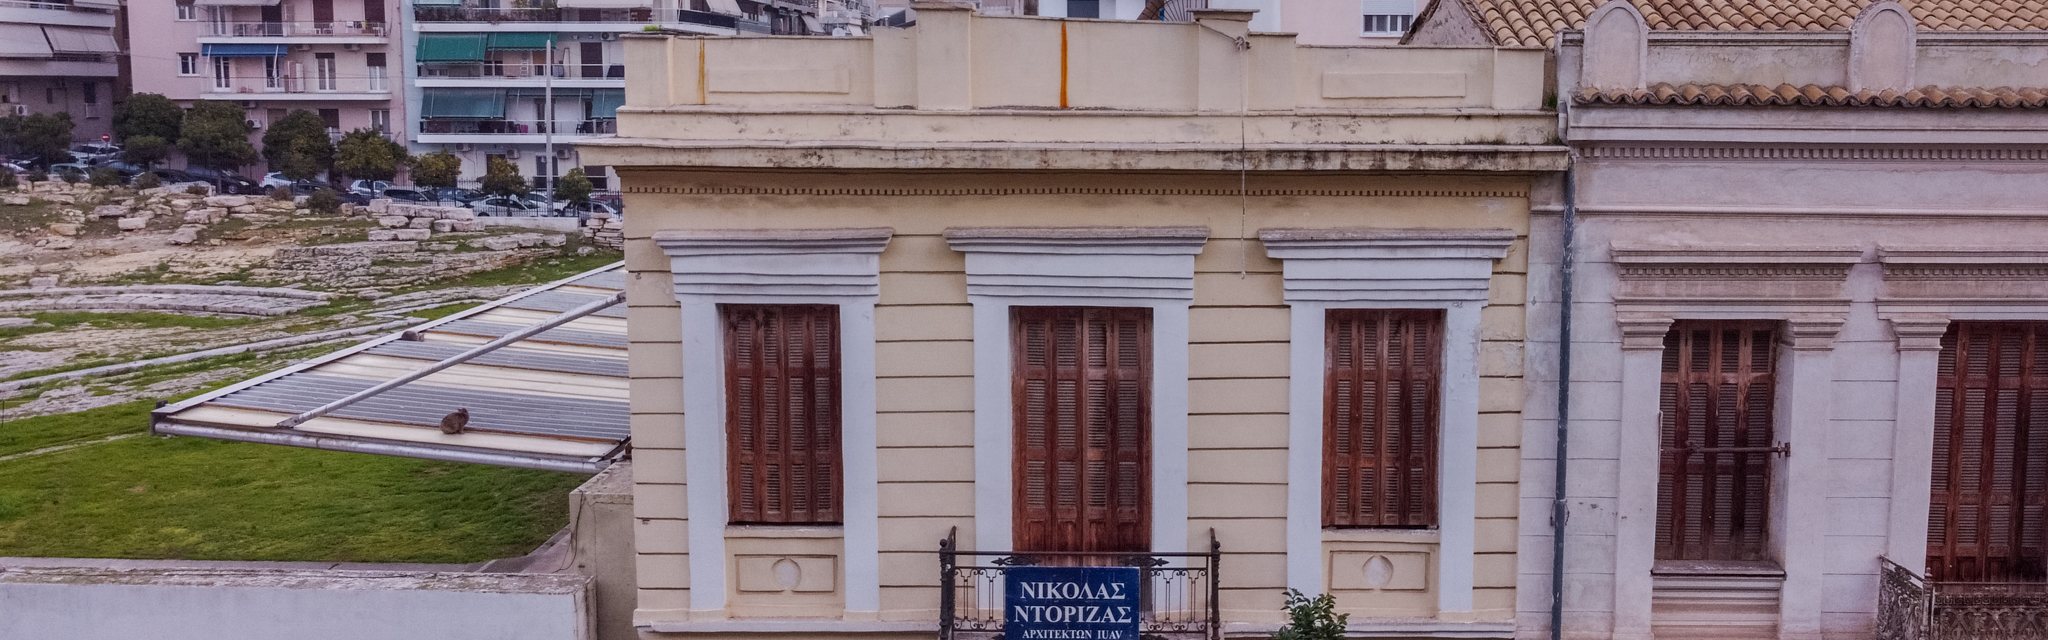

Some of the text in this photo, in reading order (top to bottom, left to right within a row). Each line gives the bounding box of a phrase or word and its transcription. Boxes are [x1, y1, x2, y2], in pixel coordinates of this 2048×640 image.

[1020, 582, 1125, 600] ΝΙΚΟΛΑΣ
[1014, 605, 1132, 623] ΝΤΟΡΙΖΑΣ
[1022, 629, 1092, 640] ΑΡΧΙΤΕΚΤΩΝ
